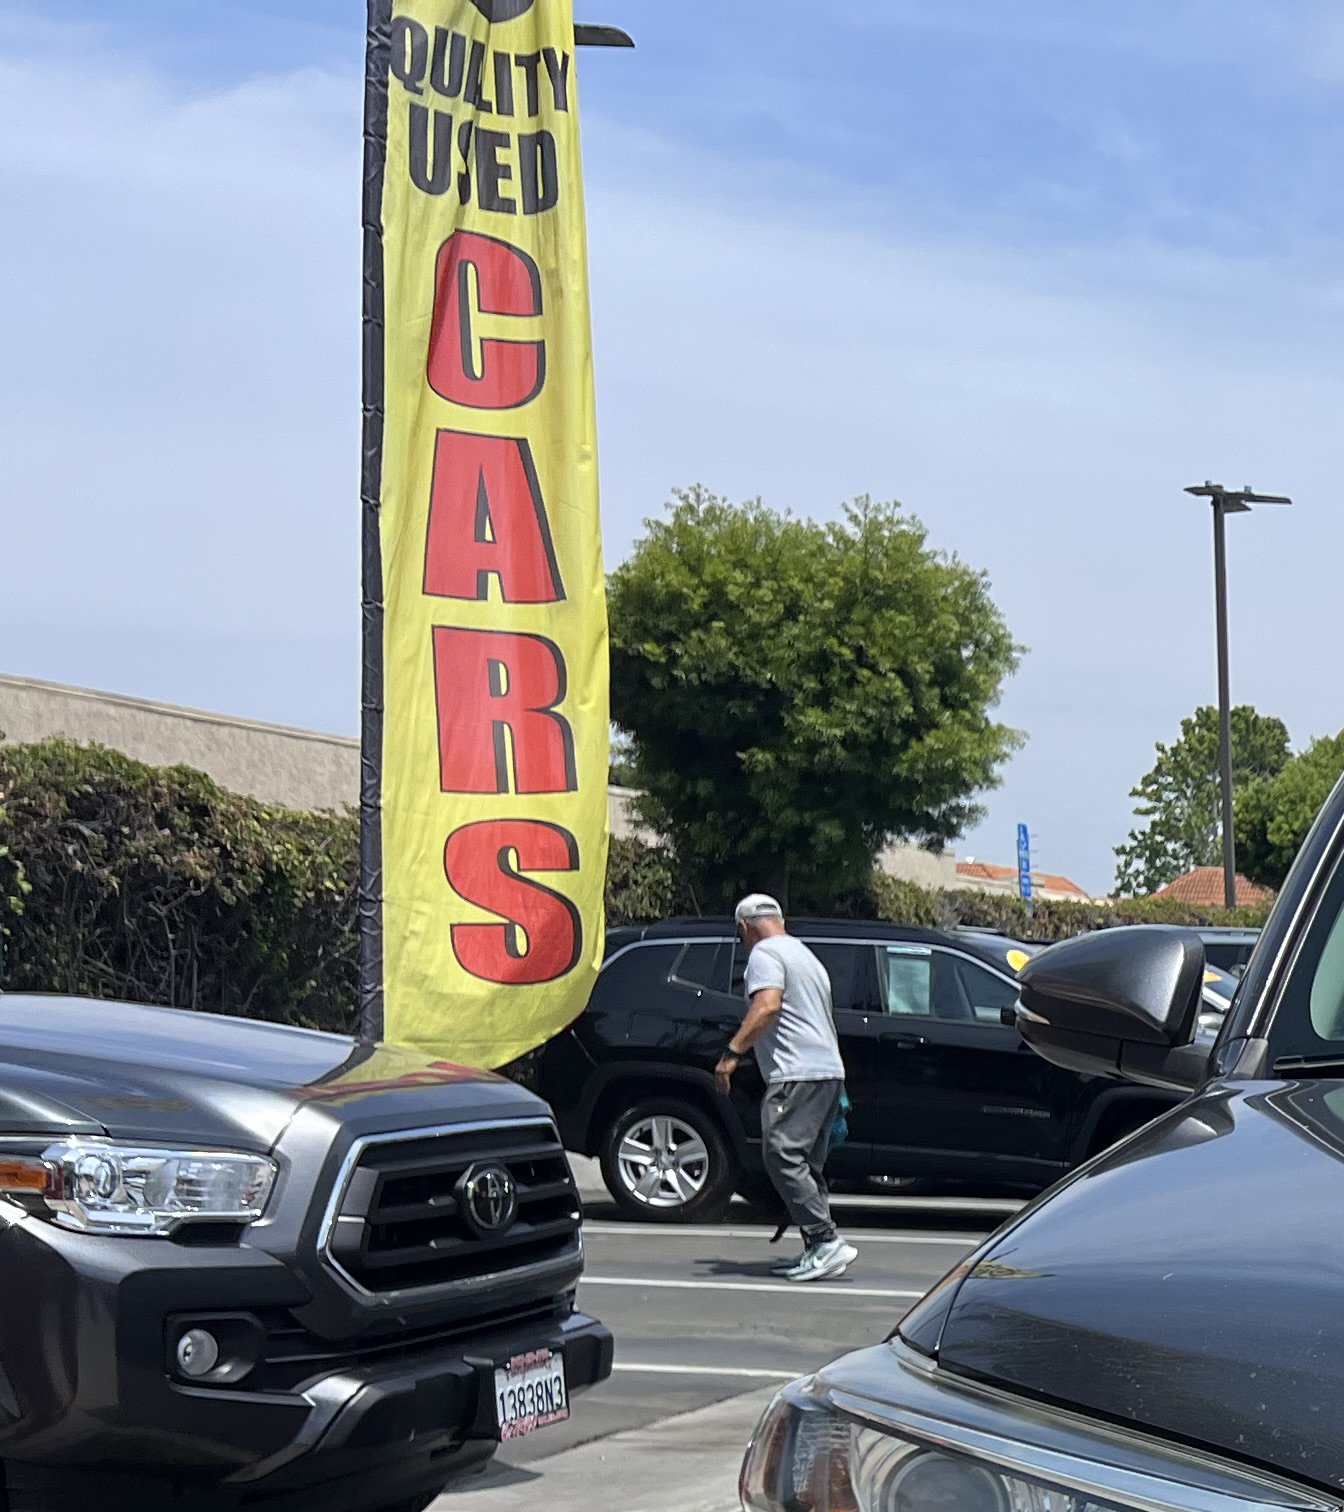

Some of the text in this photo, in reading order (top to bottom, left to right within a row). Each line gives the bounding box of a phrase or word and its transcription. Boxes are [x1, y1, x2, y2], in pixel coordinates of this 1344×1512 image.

[408, 102, 560, 216] USED
[421, 228, 581, 987] CARS
[500, 1375, 564, 1423] 13838N3
